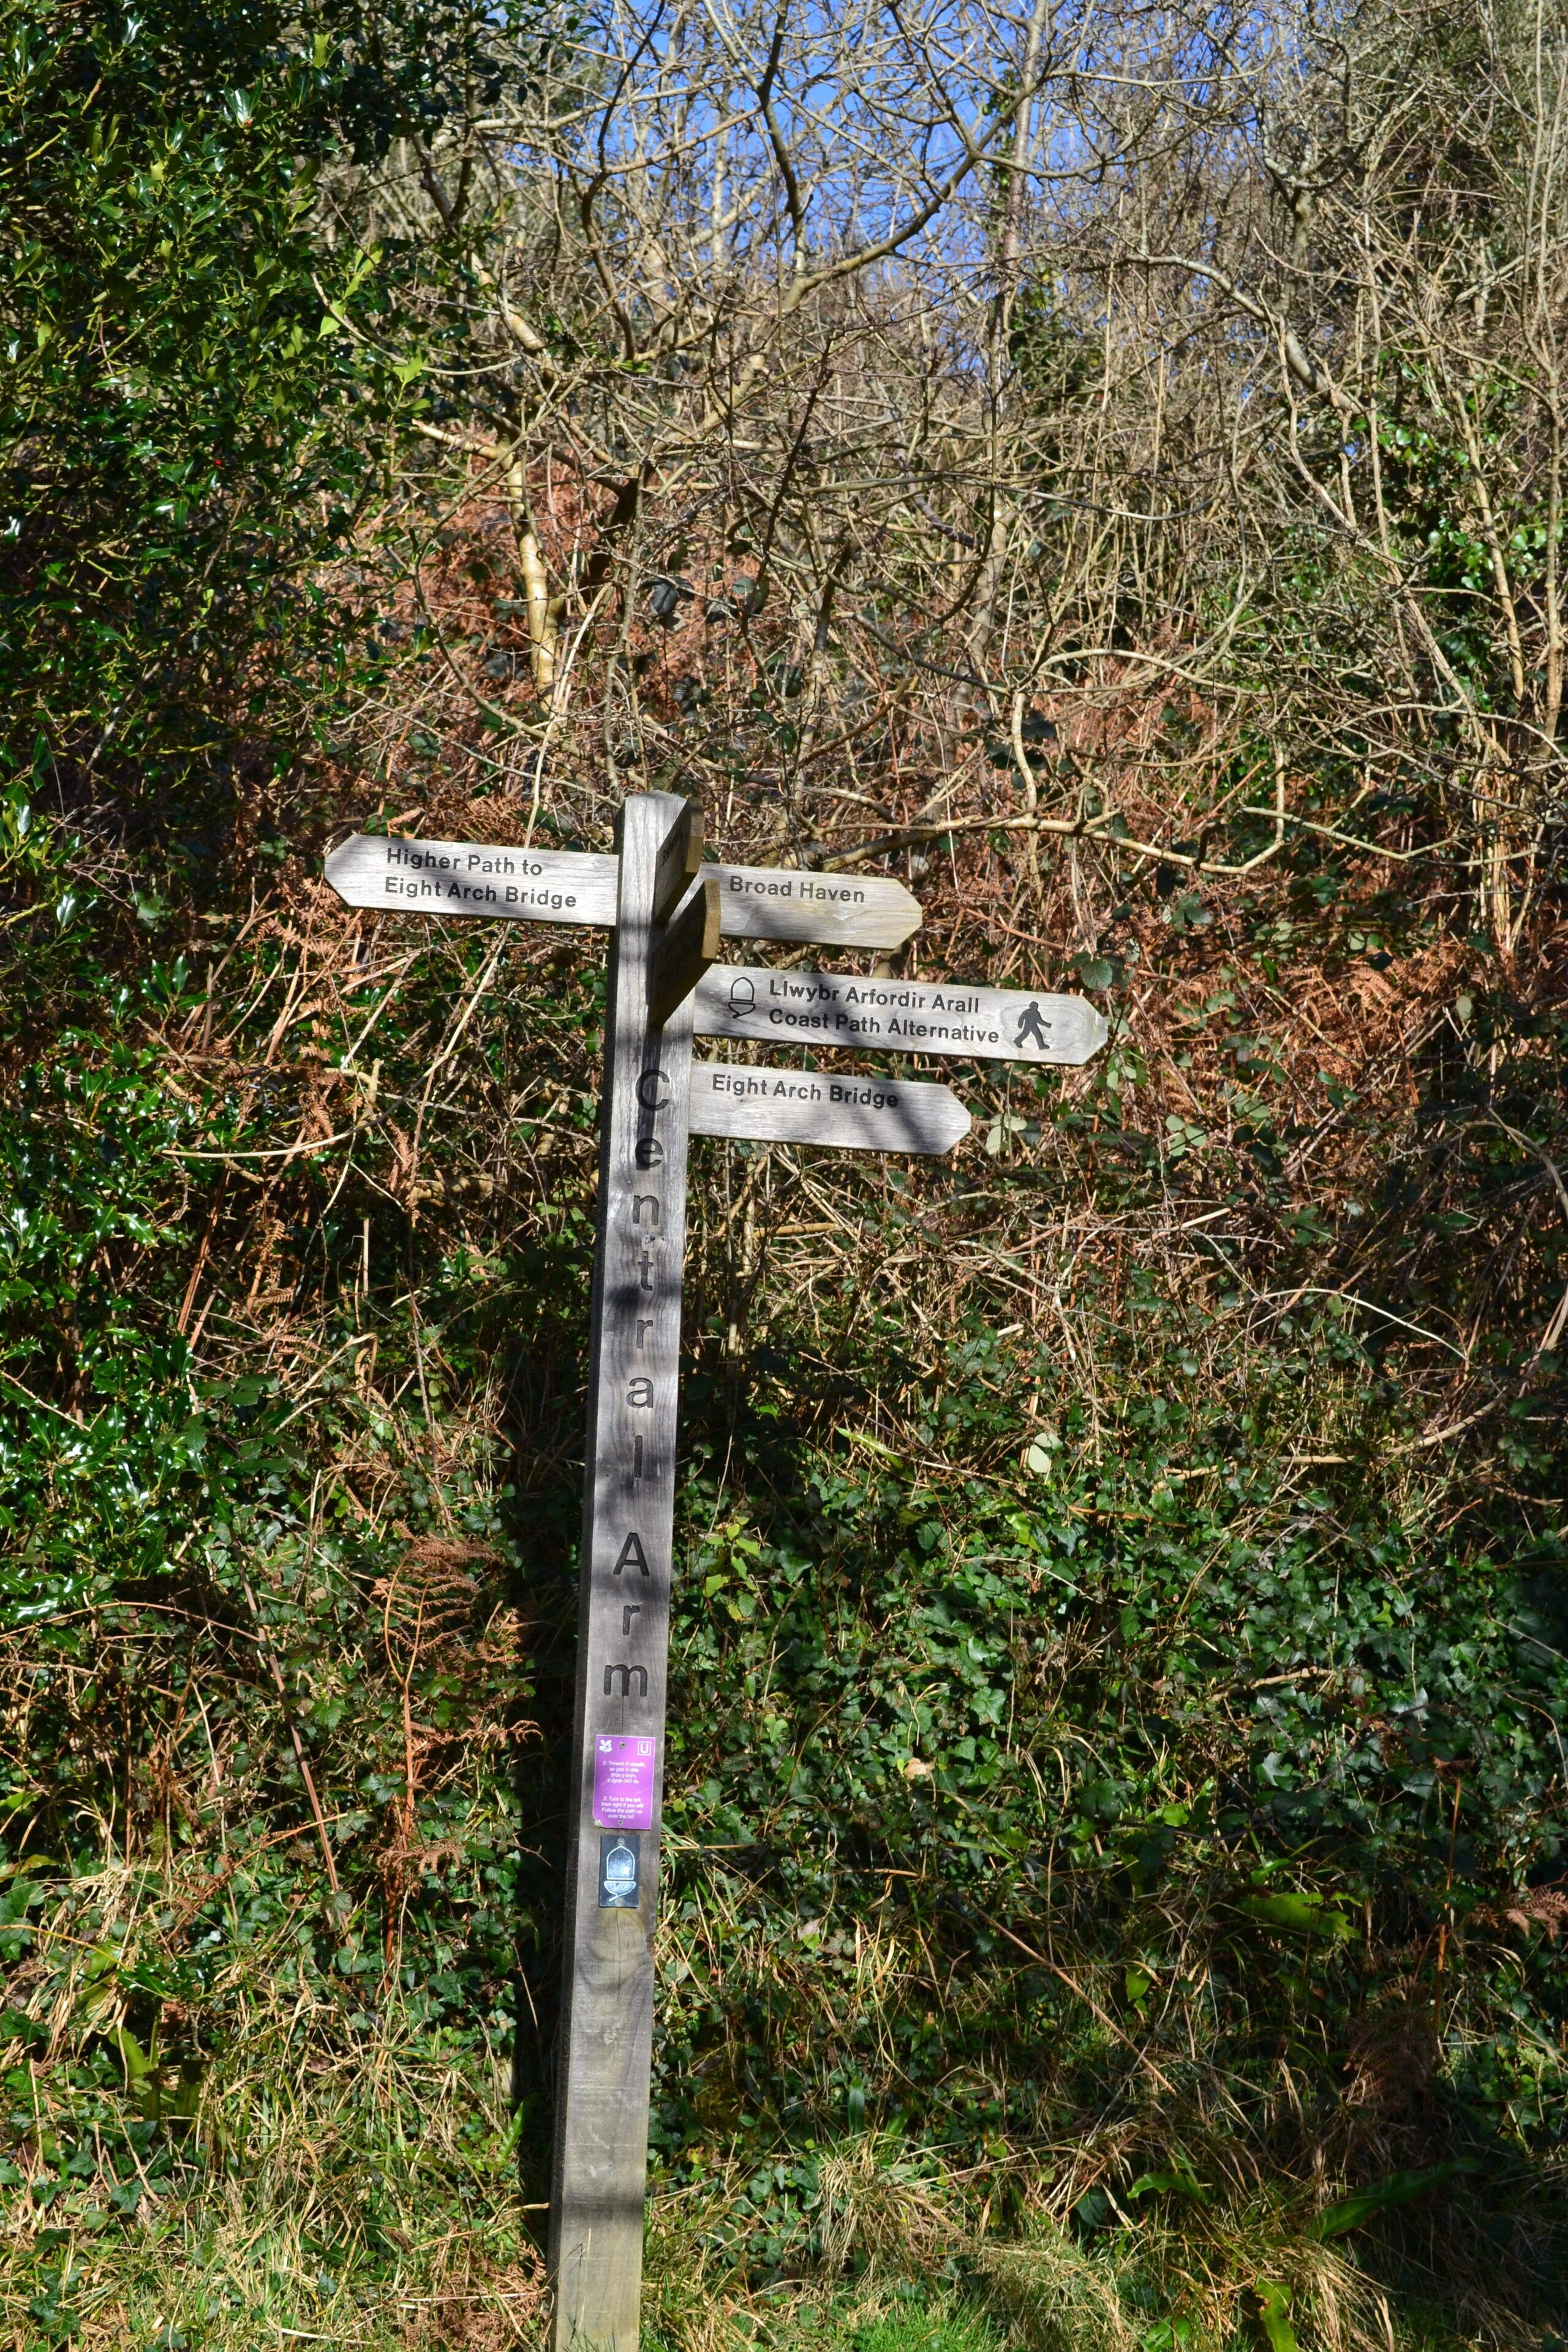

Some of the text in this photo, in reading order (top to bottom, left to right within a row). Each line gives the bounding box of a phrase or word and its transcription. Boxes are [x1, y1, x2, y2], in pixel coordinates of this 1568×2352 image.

[386, 847, 543, 876] Higher Path to
[385, 876, 577, 910] Eight Arch Bridge
[729, 875, 865, 903] Broad Haven
[769, 979, 980, 1014] Llwybr Arfordir Arall
[769, 1008, 1000, 1044] Coast Path Alternative
[712, 1073, 899, 1109] Eight Arch Bridge
[603, 1069, 669, 1697] Central Arm
[639, 1743, 649, 1754] U
